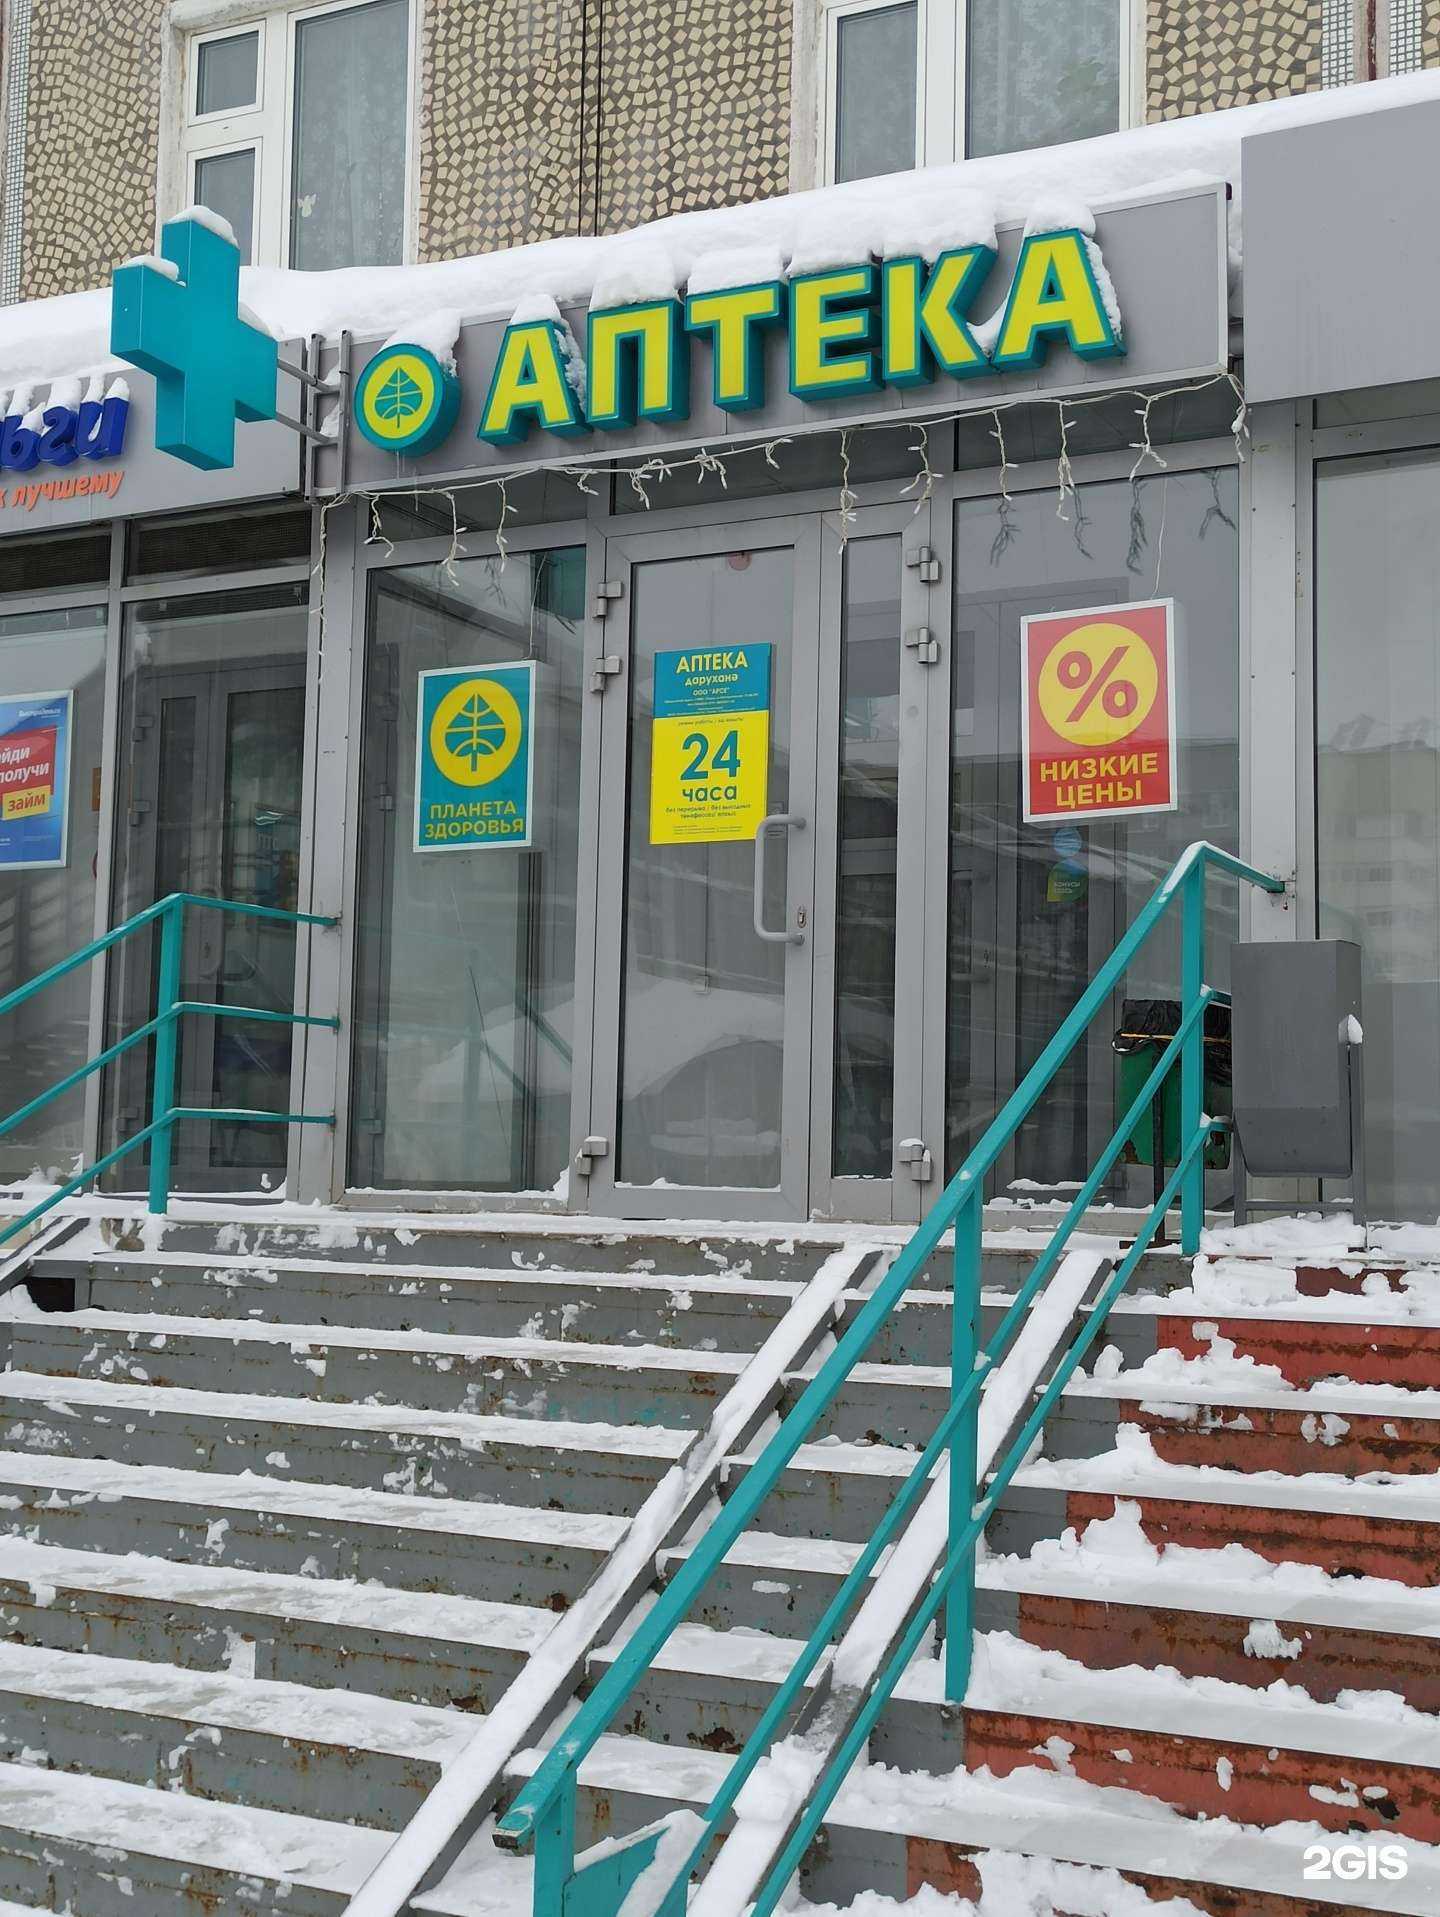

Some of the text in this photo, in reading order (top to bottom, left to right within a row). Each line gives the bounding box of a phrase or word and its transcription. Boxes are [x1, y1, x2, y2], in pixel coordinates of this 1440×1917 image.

[477, 228, 1127, 445] АПТЕКА
[0, 397, 130, 472] ьги
[11, 470, 125, 512] лучшему
[676, 651, 748, 674] АПТЕКА
[0, 747, 31, 765] йди
[680, 730, 741, 781] 24
[1039, 752, 1159, 783] НИЗКИЕ
[8, 792, 46, 812] займ
[681, 785, 738, 803] часа
[1056, 779, 1143, 809] ЦЕНЫ
[430, 800, 517, 820] ПЛАНЕТА
[425, 818, 524, 840] ЗДОРОВЬЯ
